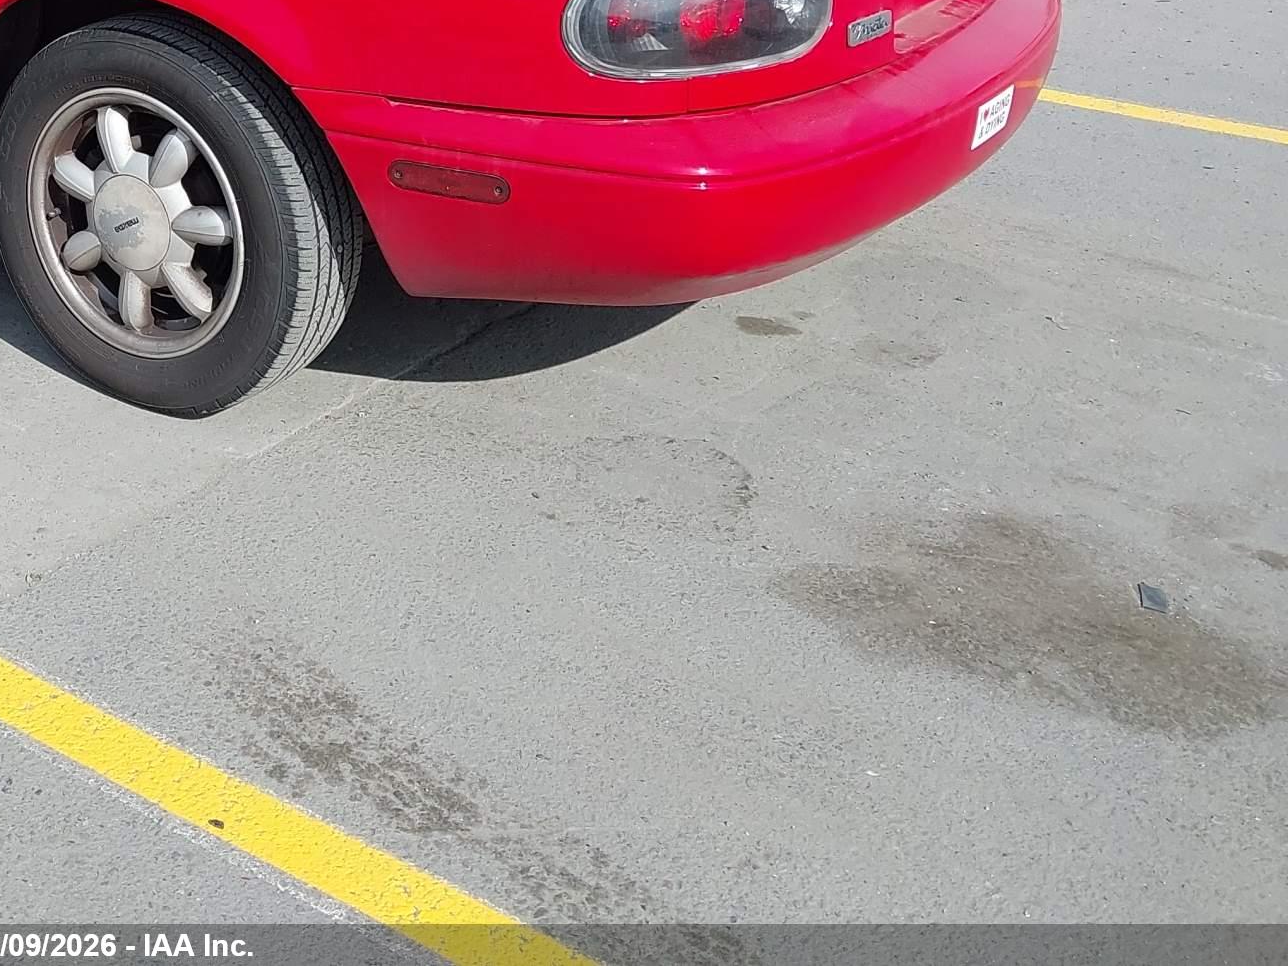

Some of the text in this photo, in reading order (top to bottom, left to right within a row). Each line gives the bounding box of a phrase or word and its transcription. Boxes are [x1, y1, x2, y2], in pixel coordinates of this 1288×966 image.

[989, 93, 1010, 116] AGING
[985, 111, 1006, 134] DYING
[114, 216, 140, 233] mazda
